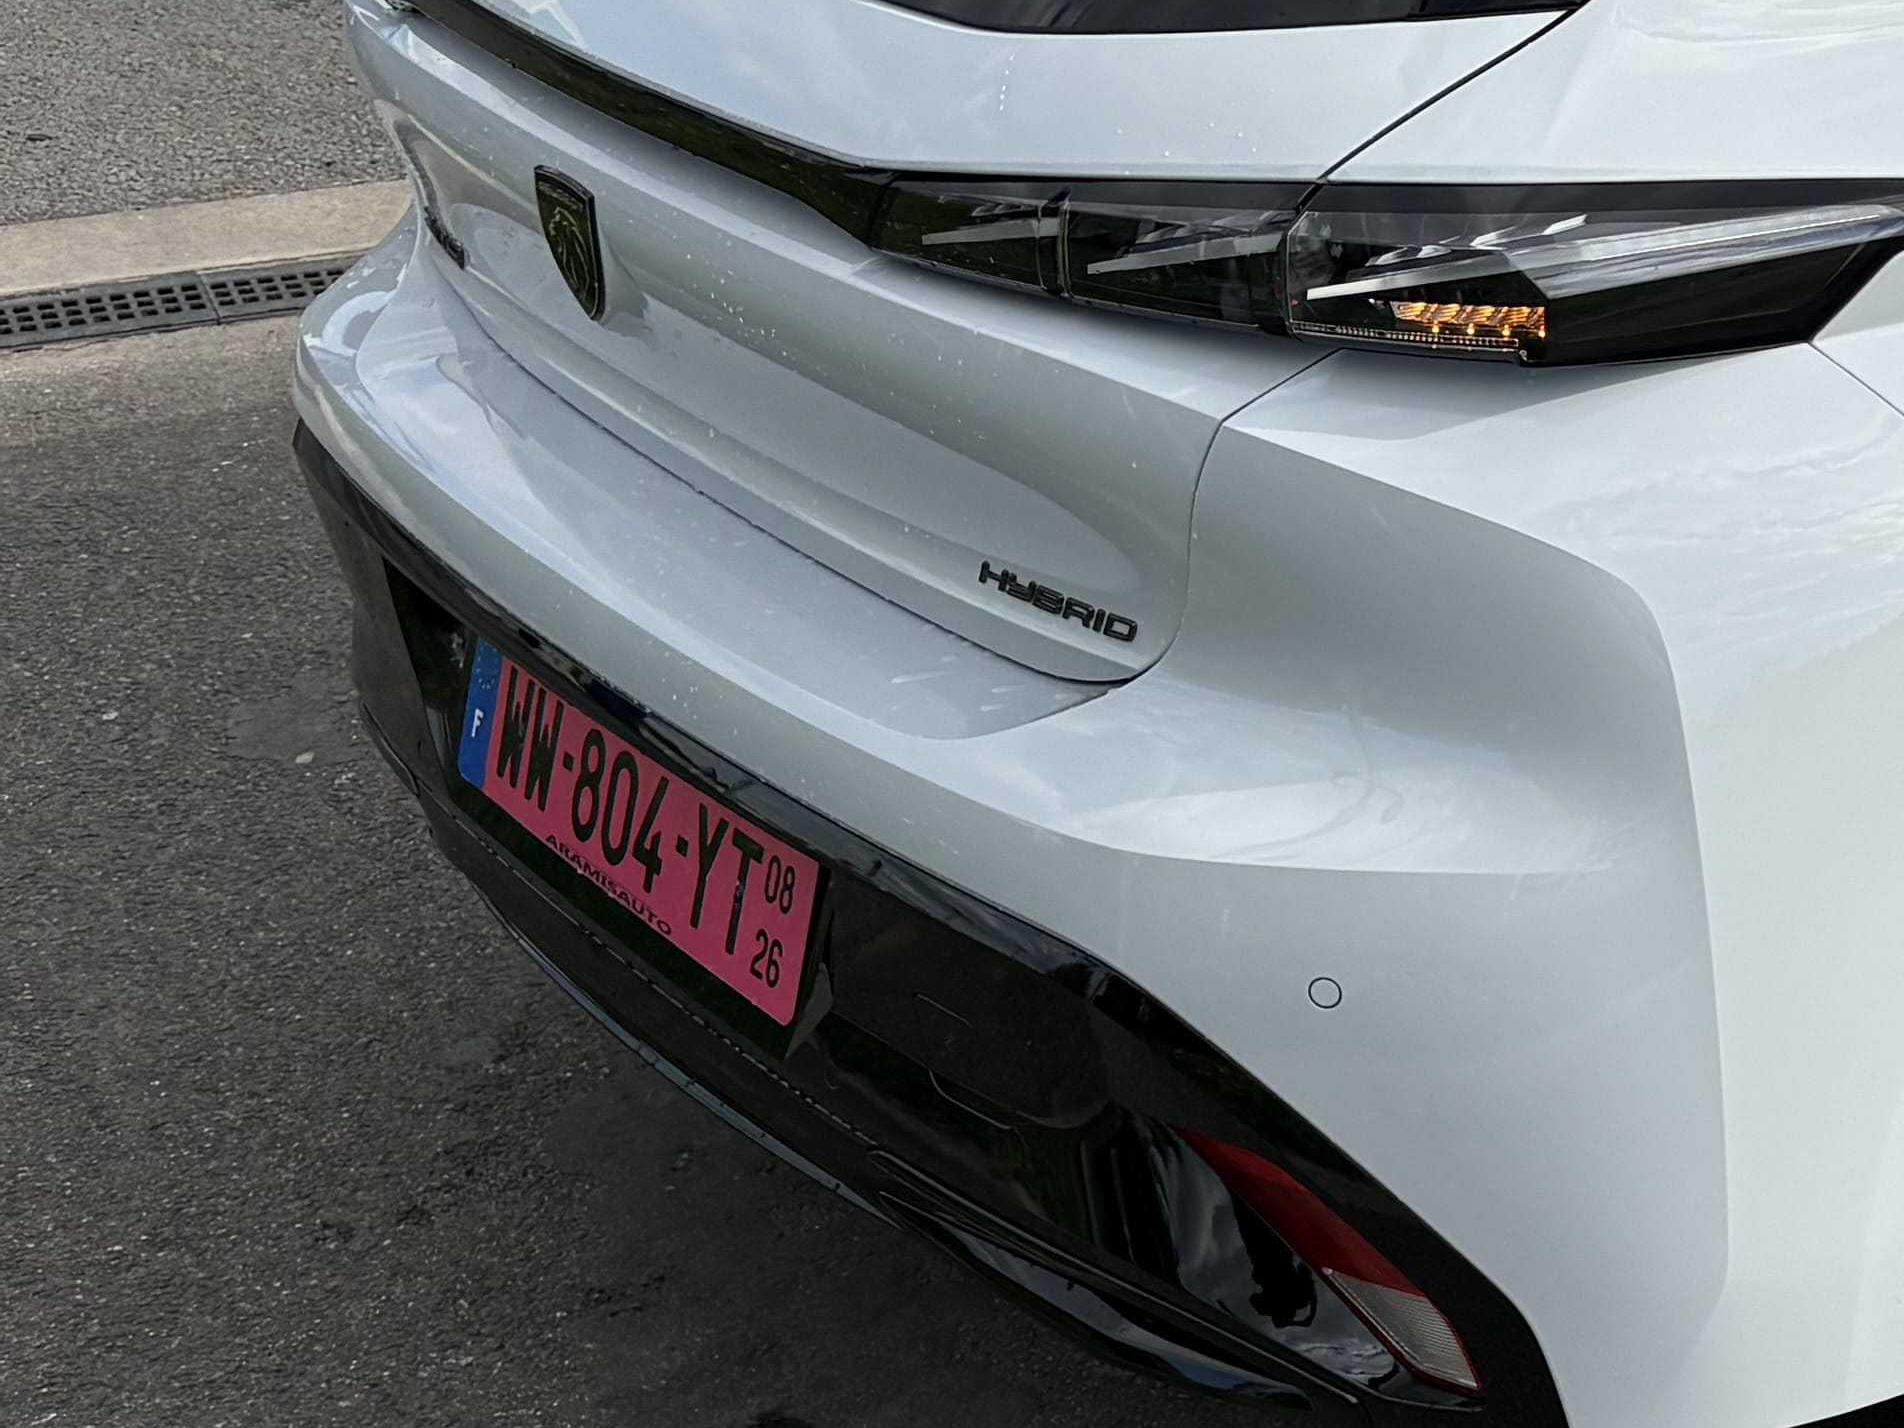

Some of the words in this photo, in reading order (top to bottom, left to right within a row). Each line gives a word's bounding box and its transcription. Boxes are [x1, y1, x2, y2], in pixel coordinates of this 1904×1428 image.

[978, 560, 1138, 642] HYBRID
[471, 708, 485, 738] F
[496, 664, 764, 956] WW-804-YT
[545, 834, 674, 937] ARAMISAUTO
[764, 855, 796, 914] 08
[750, 929, 784, 988] 26
